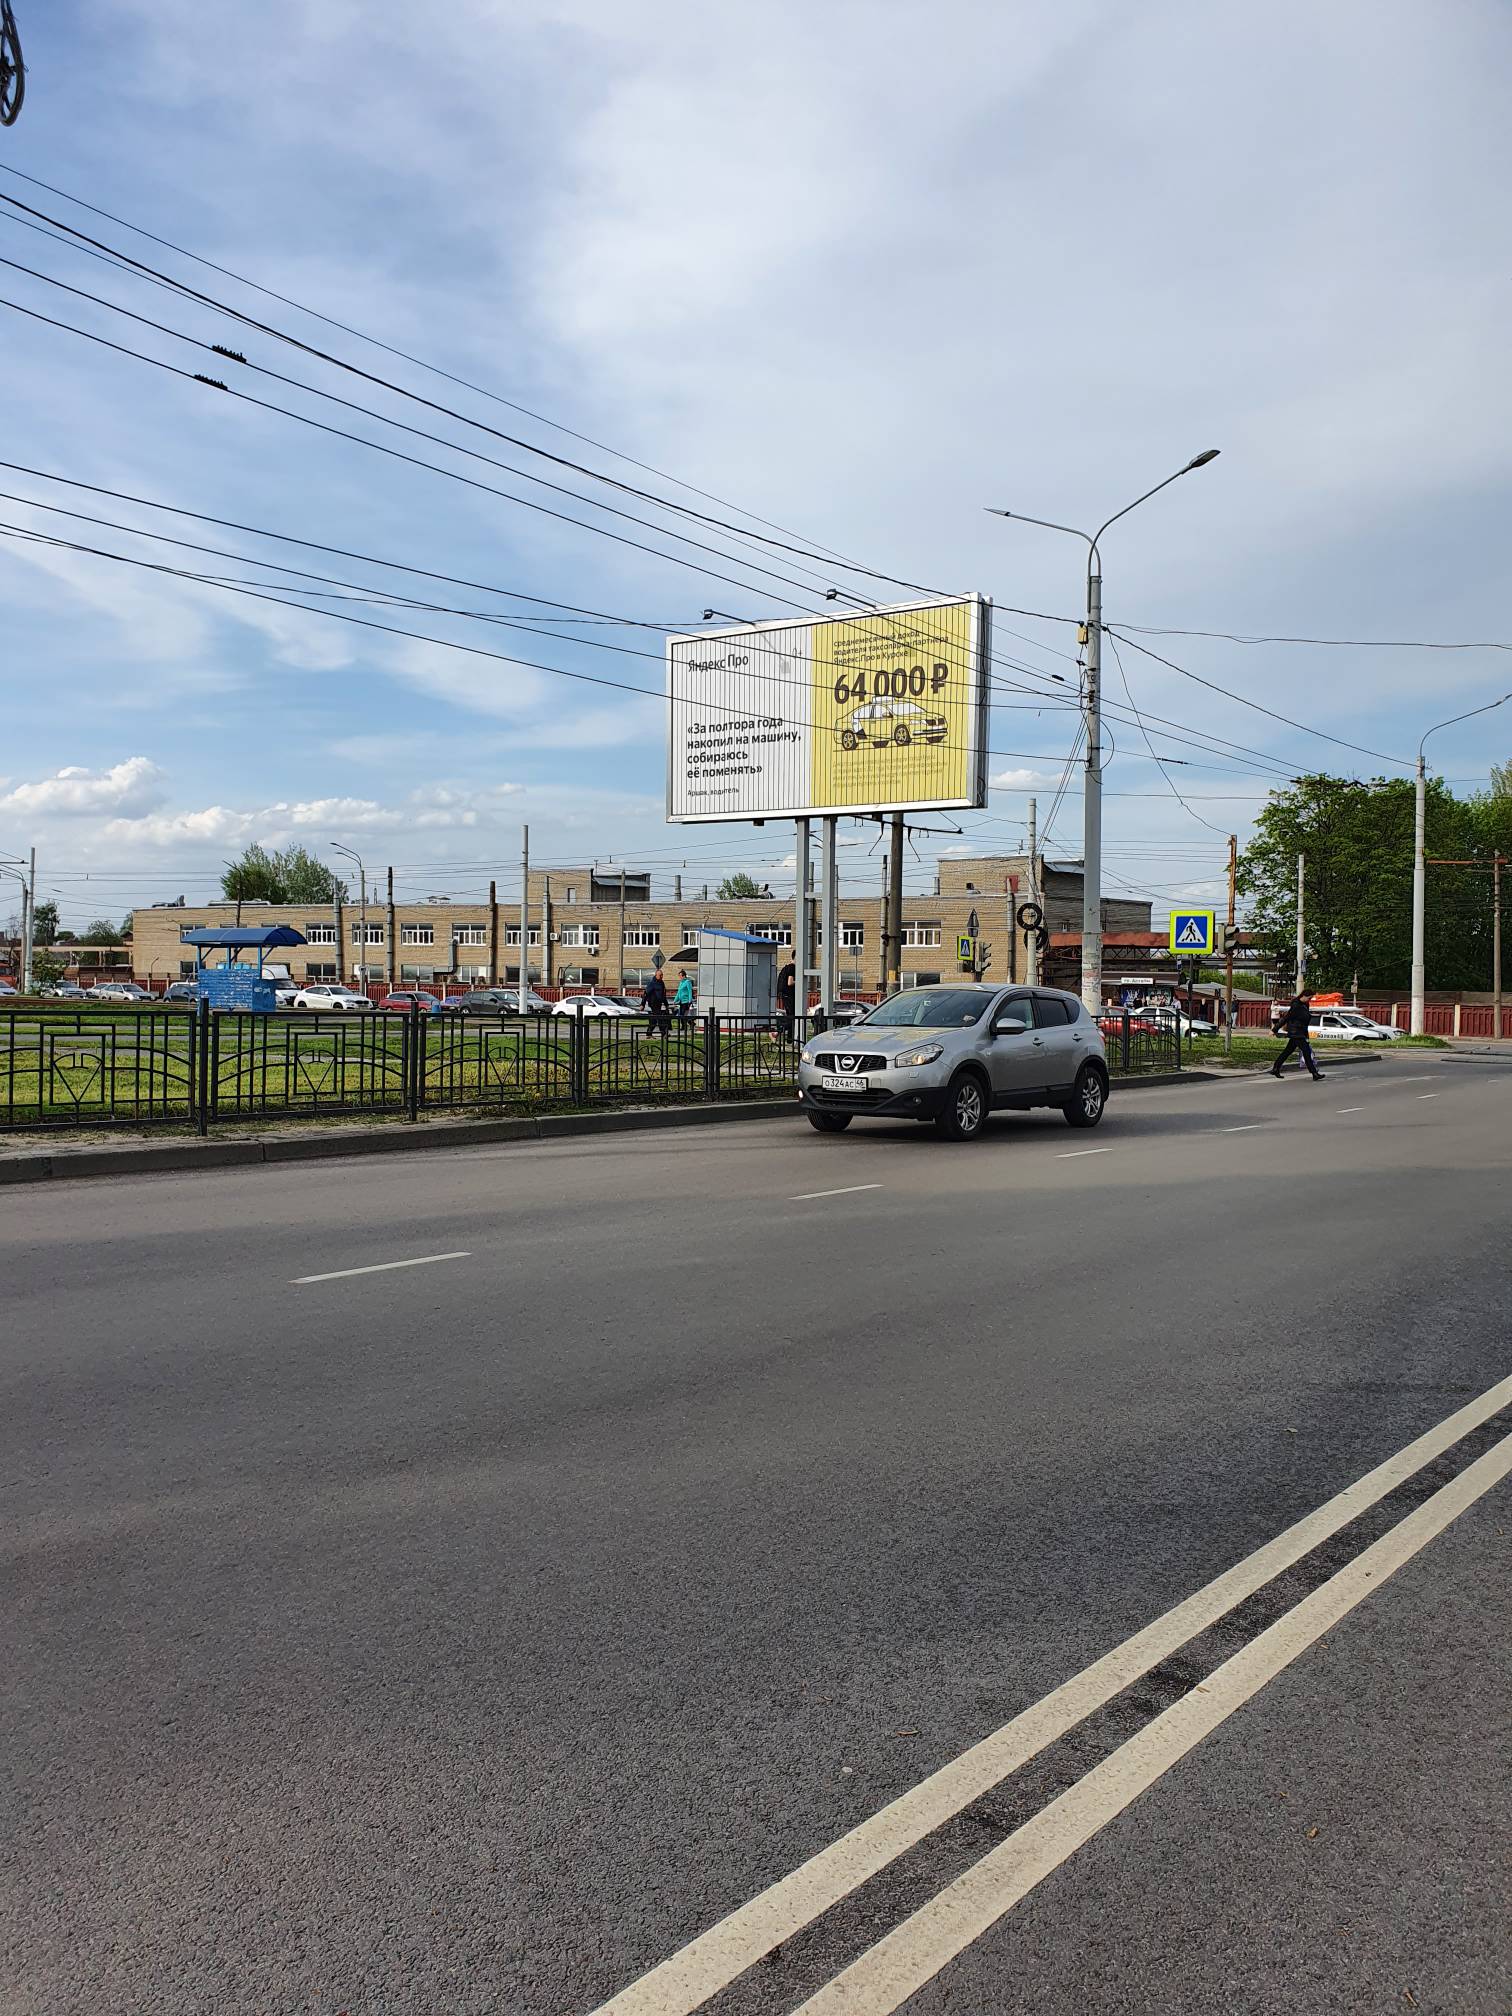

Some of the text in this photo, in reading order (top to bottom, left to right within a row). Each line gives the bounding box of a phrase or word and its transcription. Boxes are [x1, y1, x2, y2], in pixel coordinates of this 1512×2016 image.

[897, 630, 920, 640] доход
[833, 646, 867, 656] водителя
[688, 653, 749, 673] Яндекс Про
[834, 672, 867, 705] 64
[873, 665, 926, 699] 000
[688, 717, 783, 735] «За полтора года
[687, 729, 802, 750] накопил на машину,
[687, 751, 748, 764] собираюсь
[687, 764, 763, 779] её поменять»
[710, 787, 740, 796] водитель
